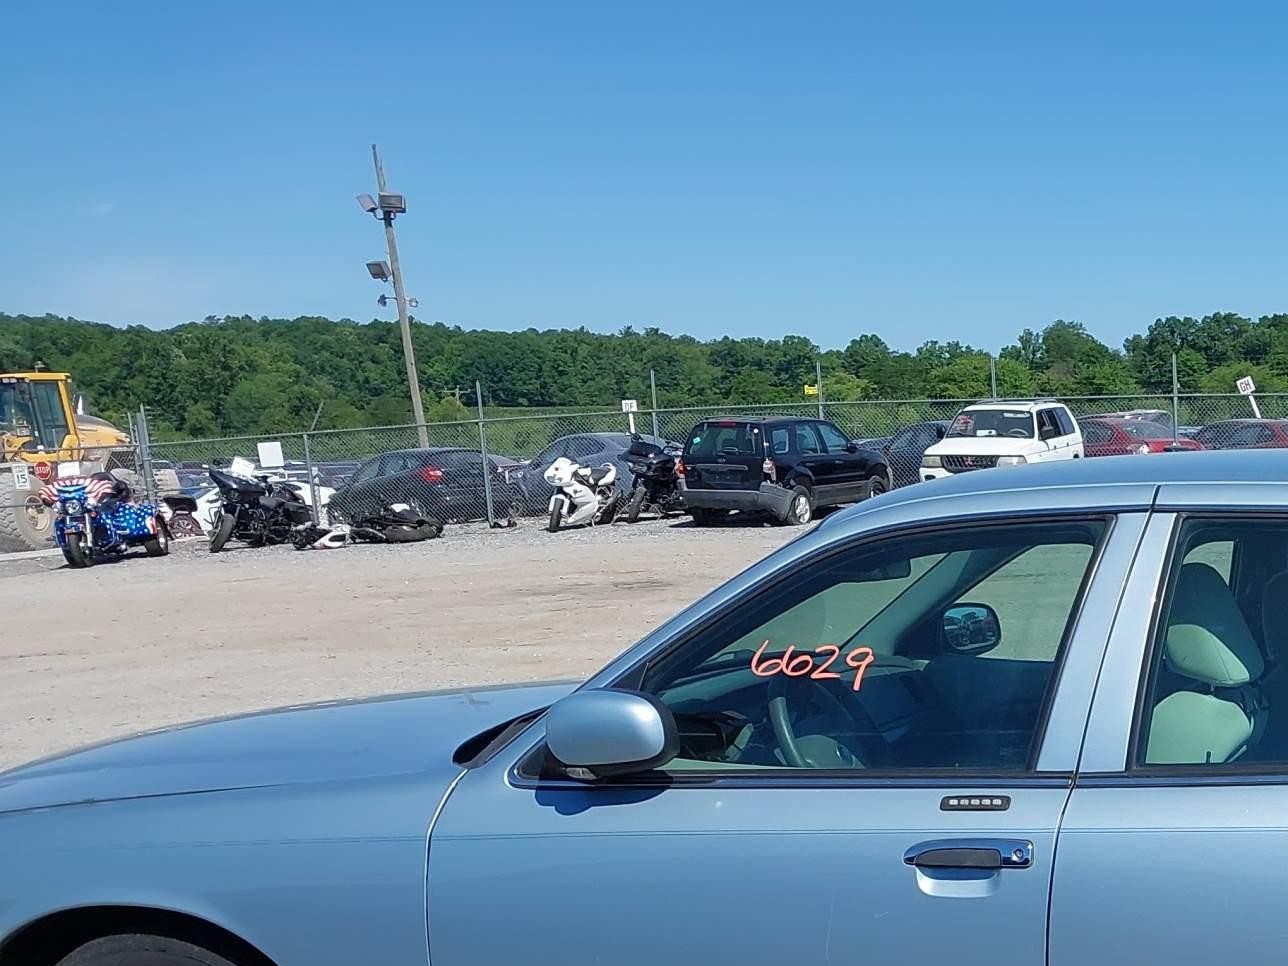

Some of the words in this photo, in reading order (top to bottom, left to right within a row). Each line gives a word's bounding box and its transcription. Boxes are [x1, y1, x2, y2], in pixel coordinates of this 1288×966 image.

[1239, 379, 1252, 392] GH
[34, 466, 50, 475] STOP
[16, 474, 27, 484] 15
[751, 639, 875, 691] 6629
